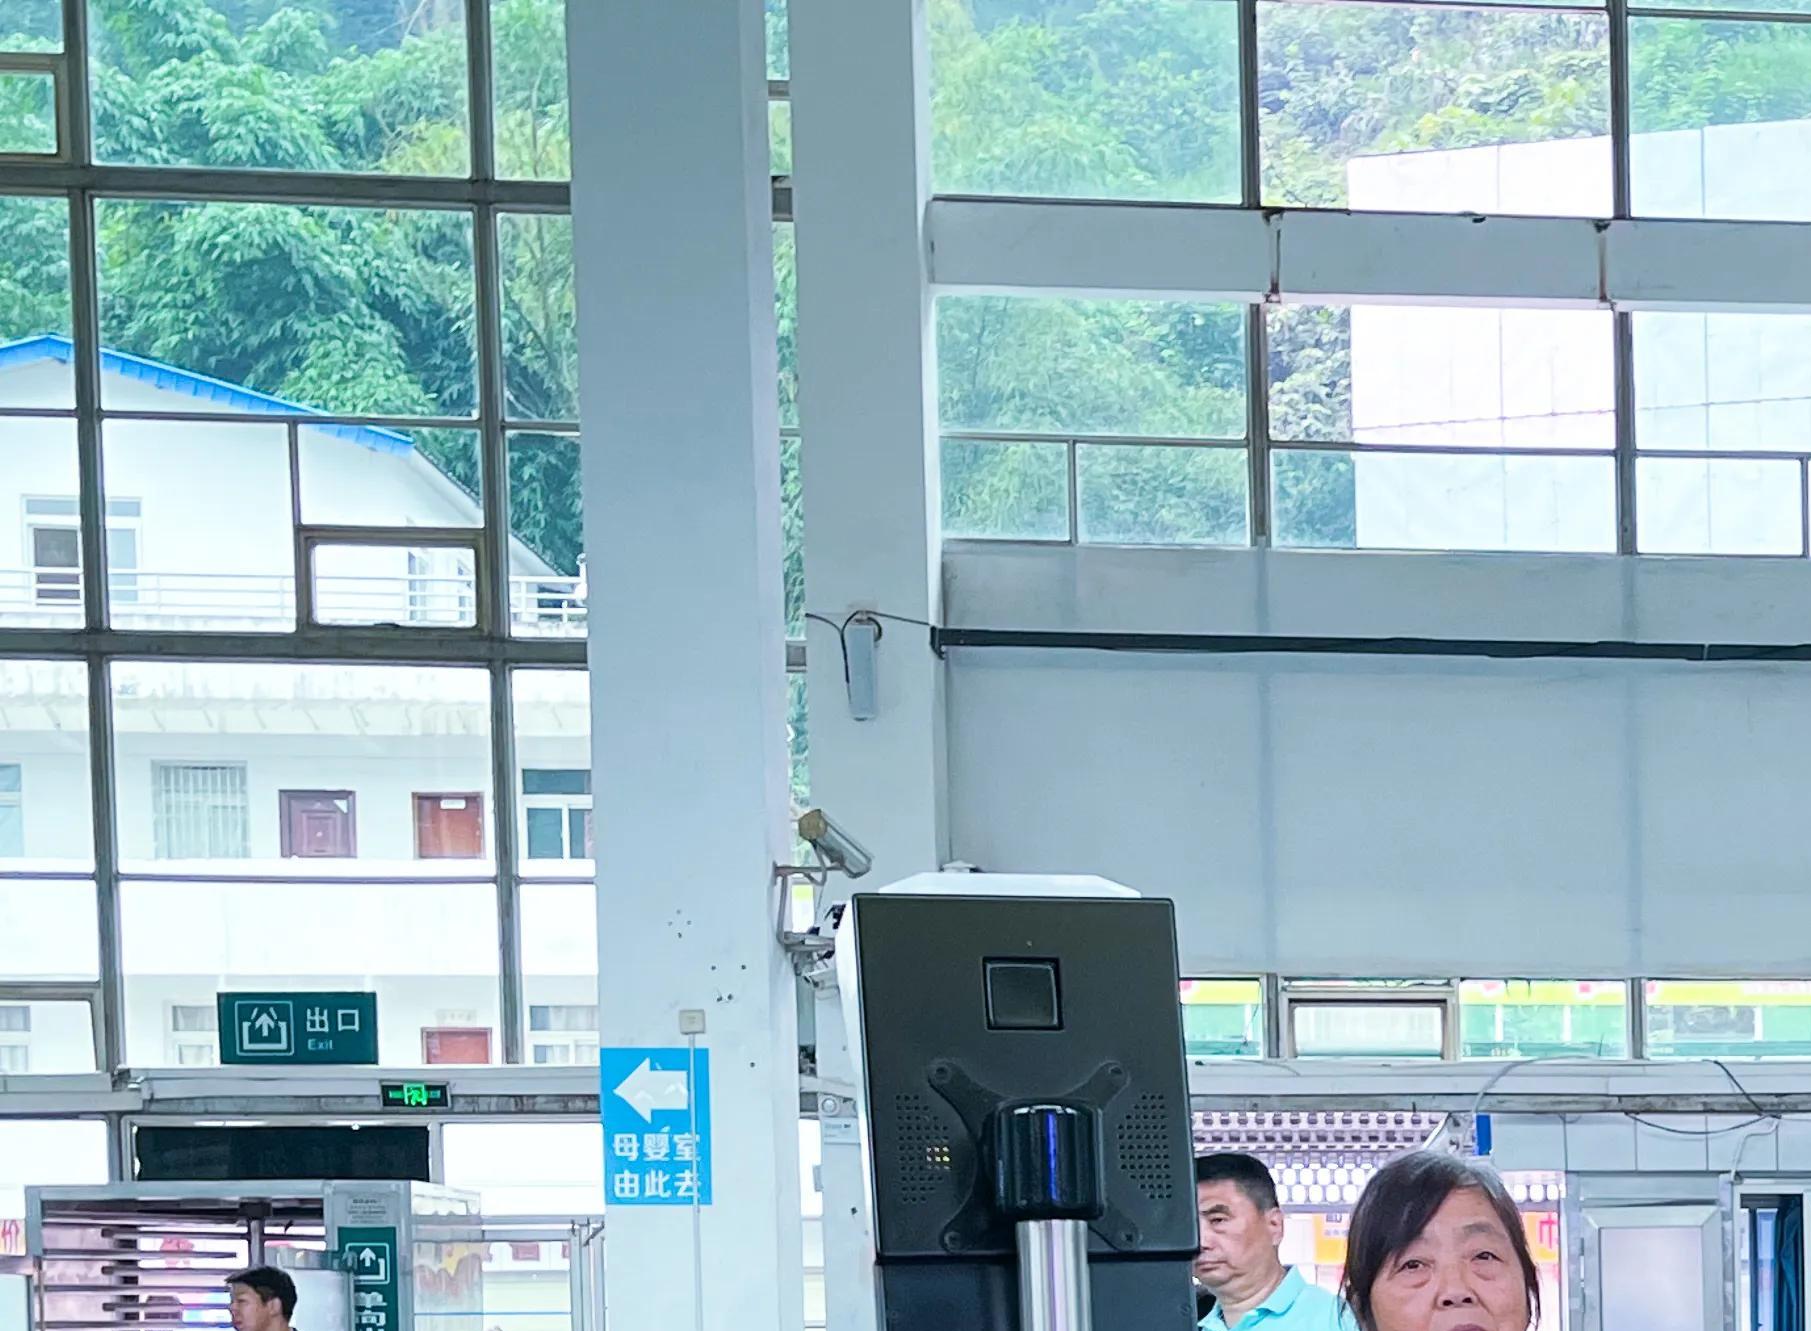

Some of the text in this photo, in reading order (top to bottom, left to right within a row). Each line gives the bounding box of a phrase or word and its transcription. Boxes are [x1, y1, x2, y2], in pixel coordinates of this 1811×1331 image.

[307, 1006, 360, 1033] 出口
[307, 1039, 333, 1051] Exit
[612, 1132, 701, 1161] 母婴室
[613, 1169, 702, 1198] 由此去
